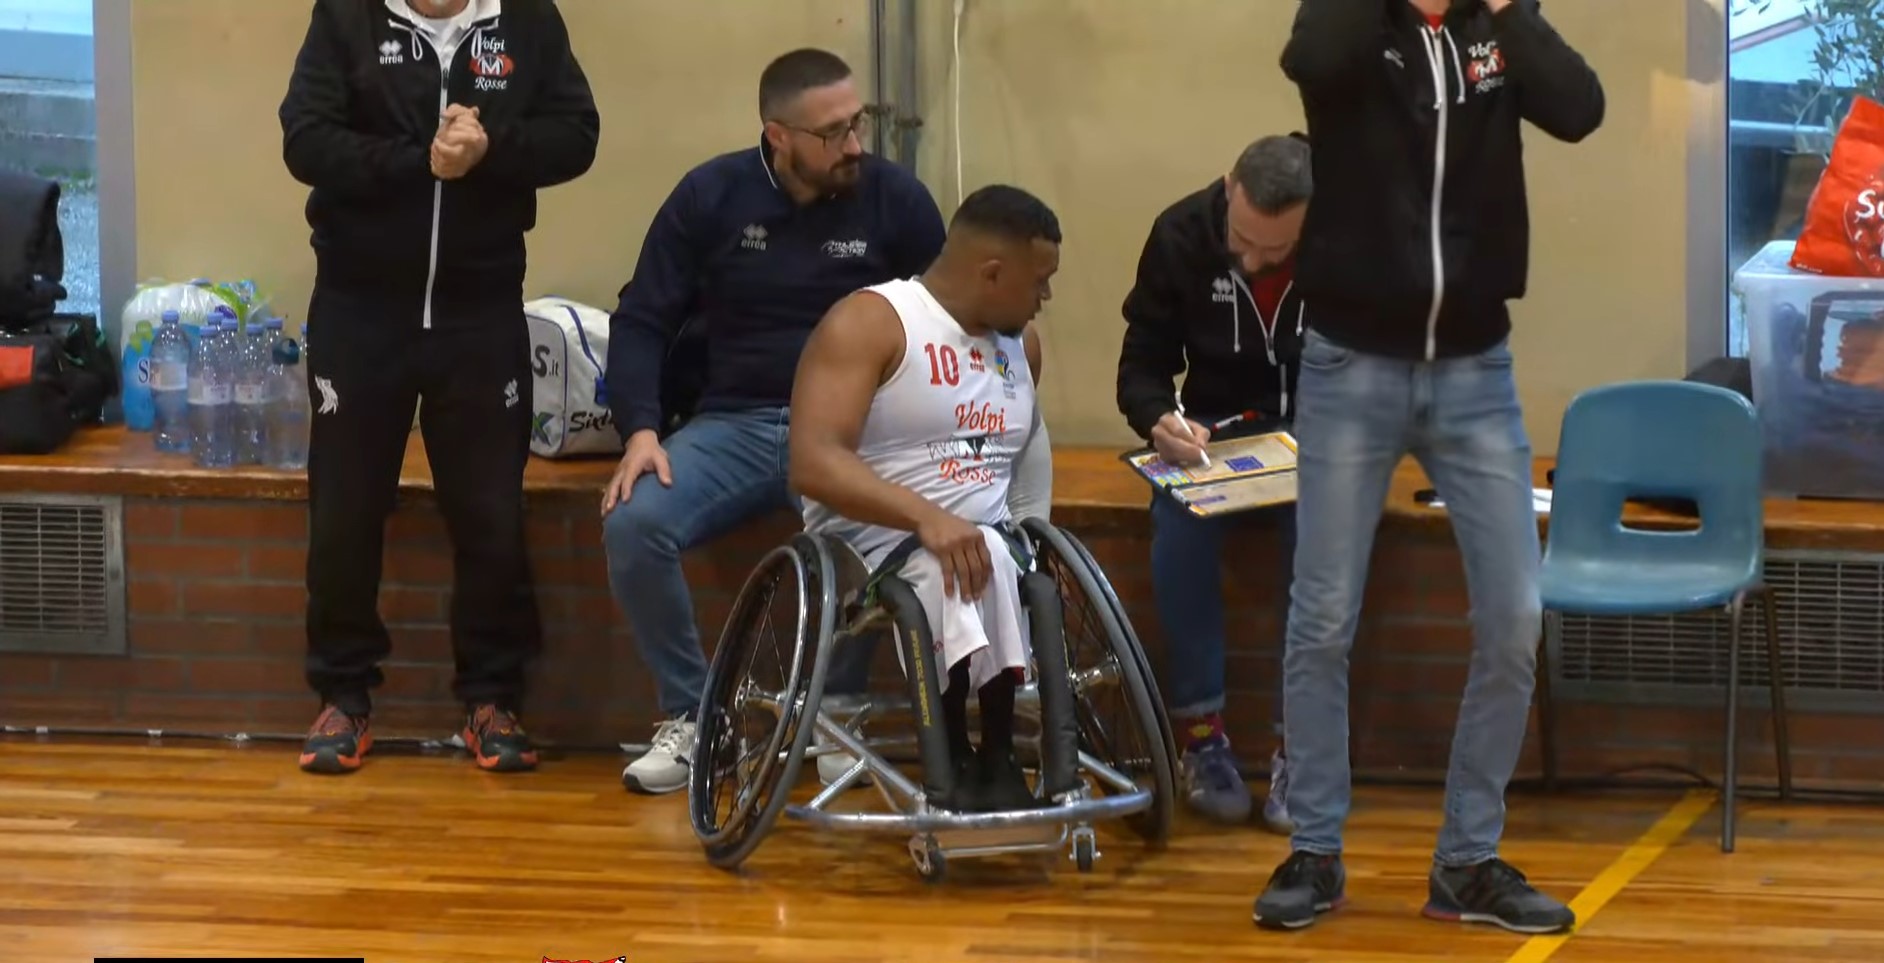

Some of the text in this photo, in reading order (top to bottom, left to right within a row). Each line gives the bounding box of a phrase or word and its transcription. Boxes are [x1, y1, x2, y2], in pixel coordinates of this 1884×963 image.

[475, 77, 507, 91] Rosse
[531, 344, 559, 378] S.it
[924, 342, 960, 386] 10
[569, 409, 613, 433] Sixt
[954, 399, 1007, 435] Volpi
[939, 457, 997, 486] Rosse
